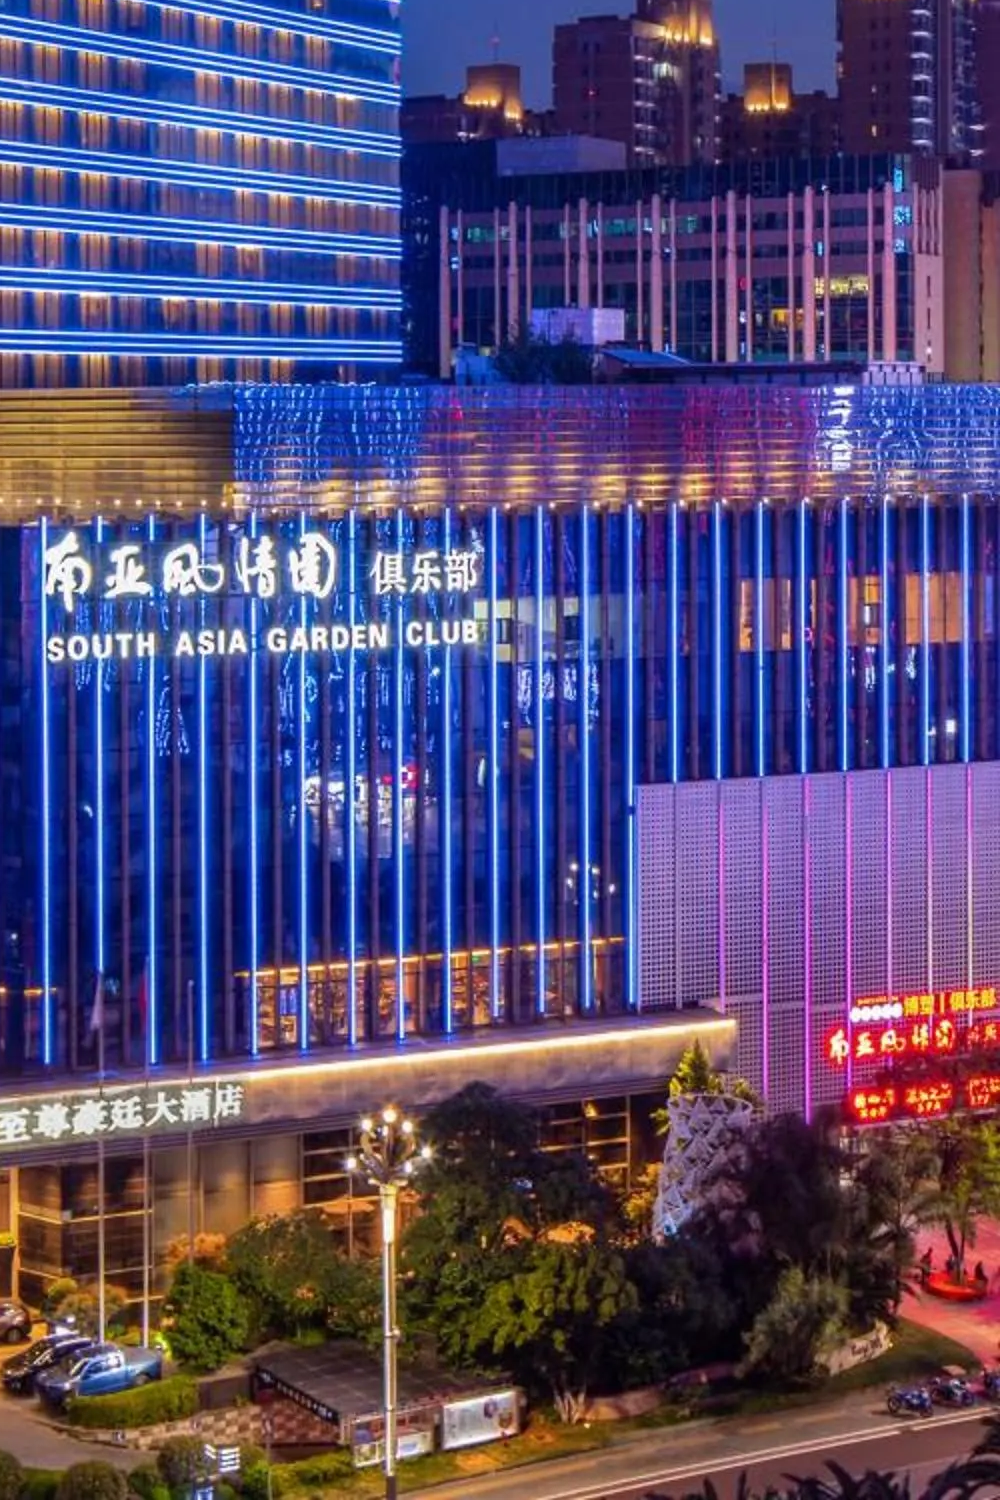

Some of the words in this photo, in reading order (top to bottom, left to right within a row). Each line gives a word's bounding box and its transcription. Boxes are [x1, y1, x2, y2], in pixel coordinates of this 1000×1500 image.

[370, 548, 478, 595] 俱乐部
[47, 632, 156, 662] SOUTH
[175, 628, 248, 657] ASIA
[267, 622, 388, 653] GARDEN
[406, 619, 479, 647] CLUB
